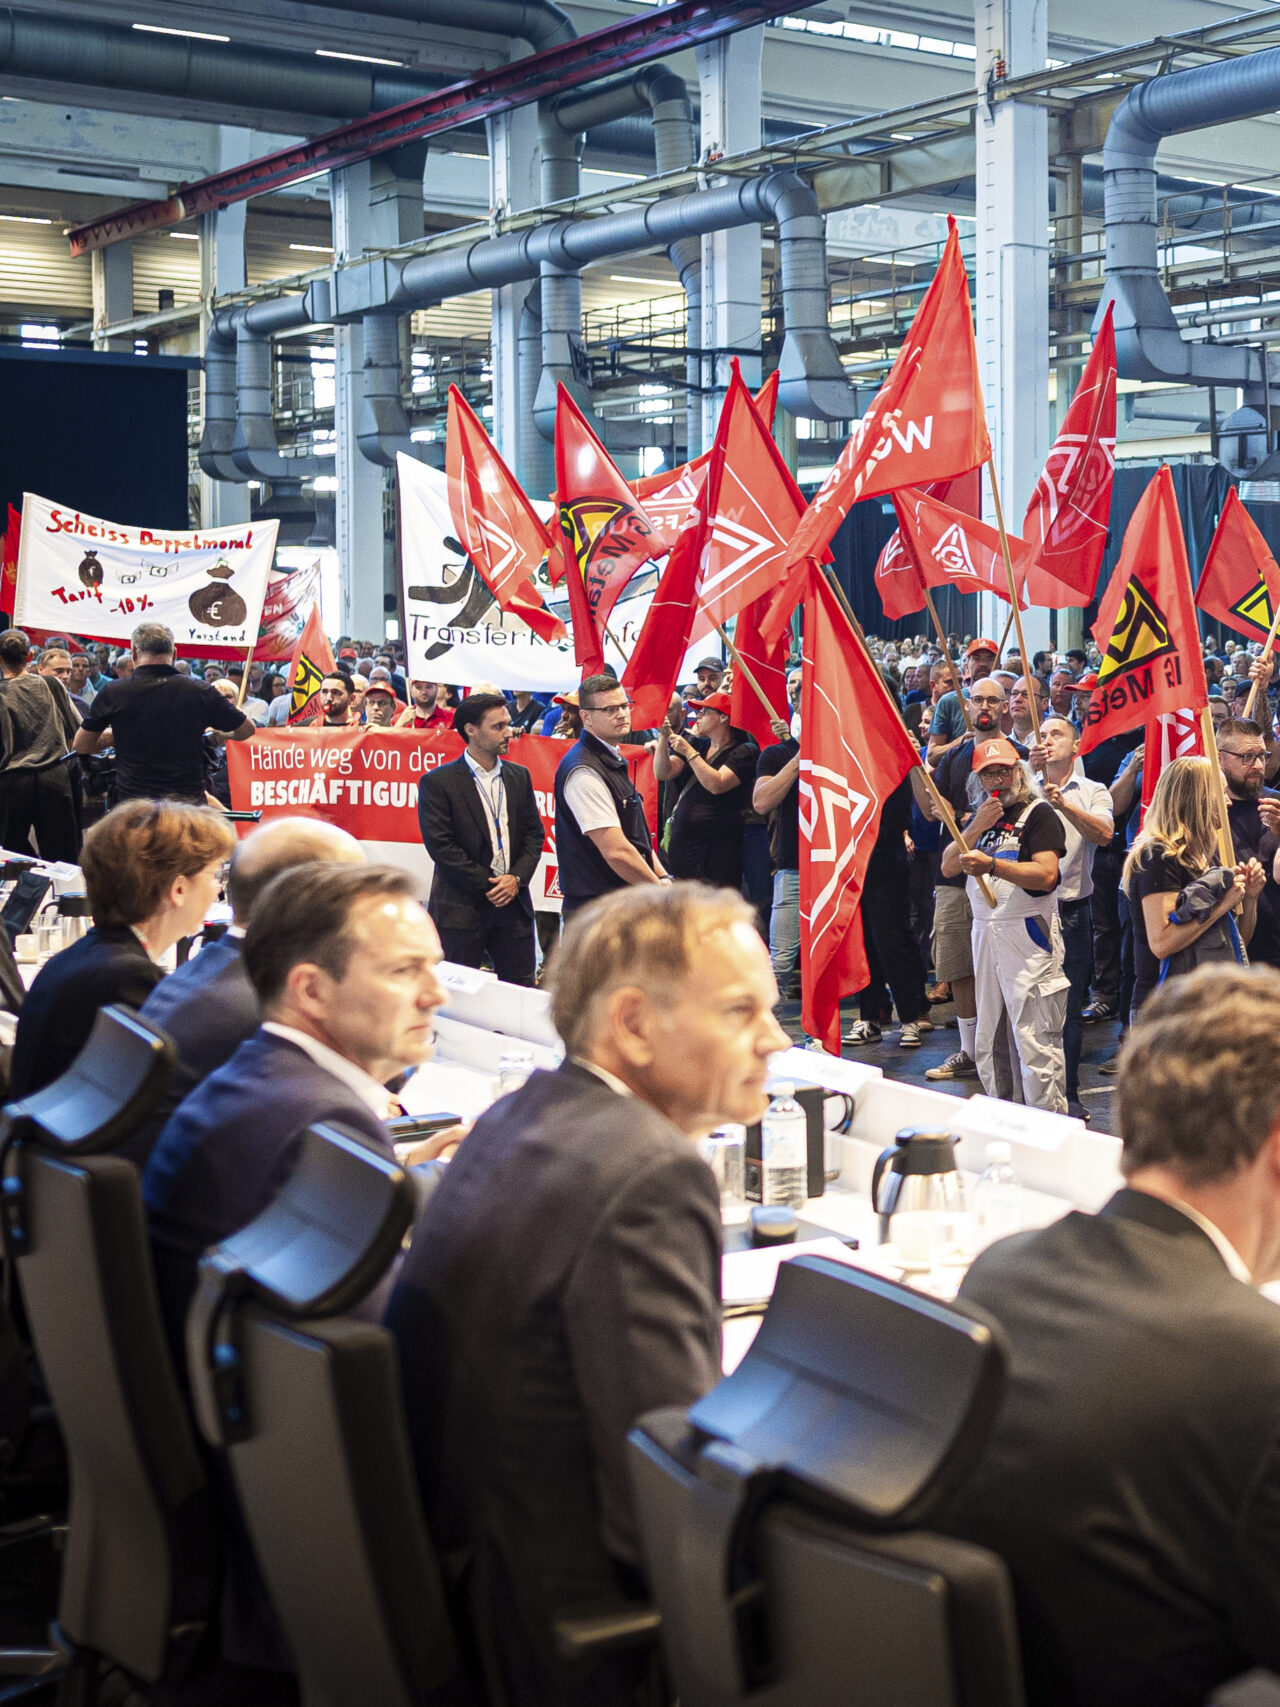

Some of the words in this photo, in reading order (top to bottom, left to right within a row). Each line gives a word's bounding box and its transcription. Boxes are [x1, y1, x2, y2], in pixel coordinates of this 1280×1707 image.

[46, 510, 130, 544] Scheiss
[139, 530, 253, 554] Doppelmoral
[51, 581, 103, 604] Tarif
[250, 743, 305, 771] Hände
[310, 747, 354, 775] weg
[360, 749, 401, 771] von
[408, 746, 446, 773] der
